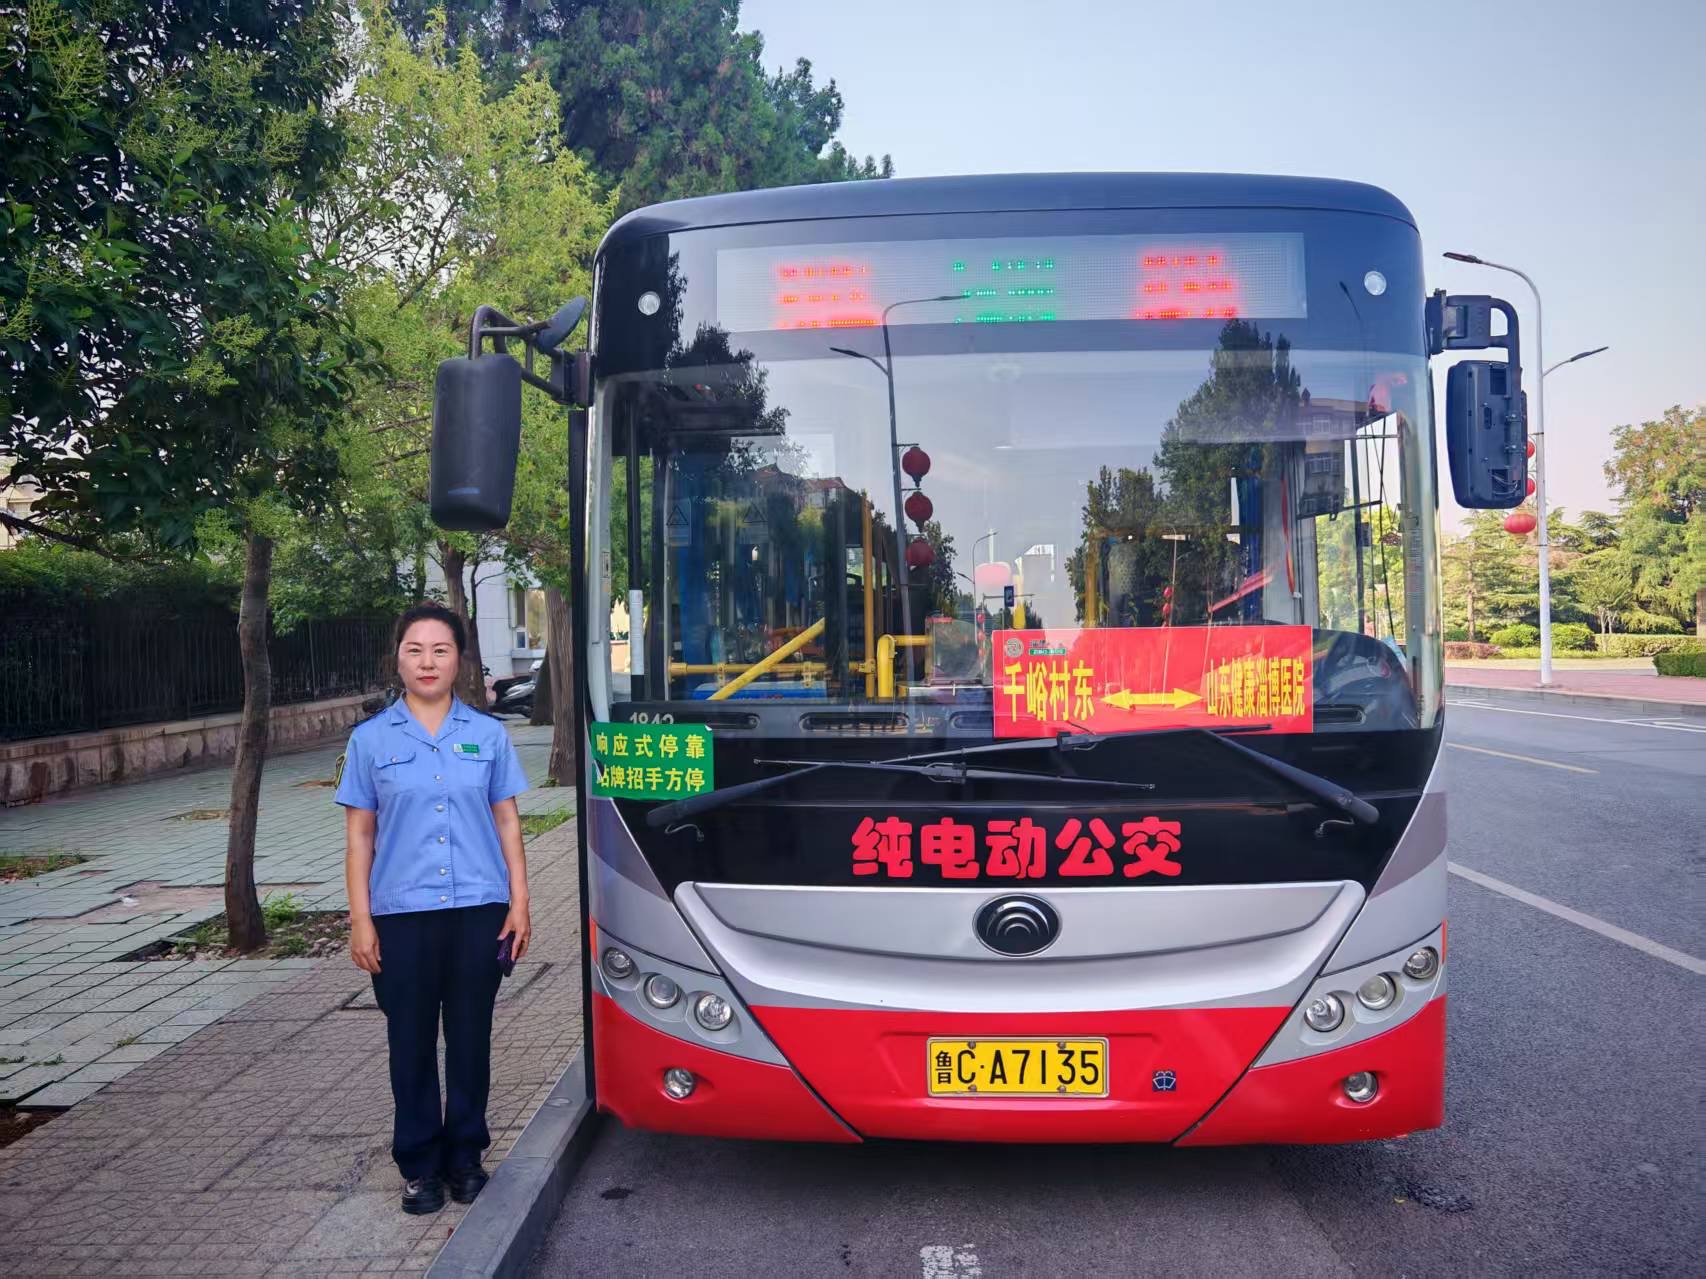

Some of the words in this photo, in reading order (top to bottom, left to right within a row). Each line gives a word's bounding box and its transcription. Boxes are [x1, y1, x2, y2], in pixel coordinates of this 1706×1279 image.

[1003, 660, 1095, 722] 千峪村东
[1207, 656, 1305, 720] 山东健康淄博医院
[596, 732, 704, 758] 响应式停靠
[851, 816, 1182, 879] 纯电动公交
